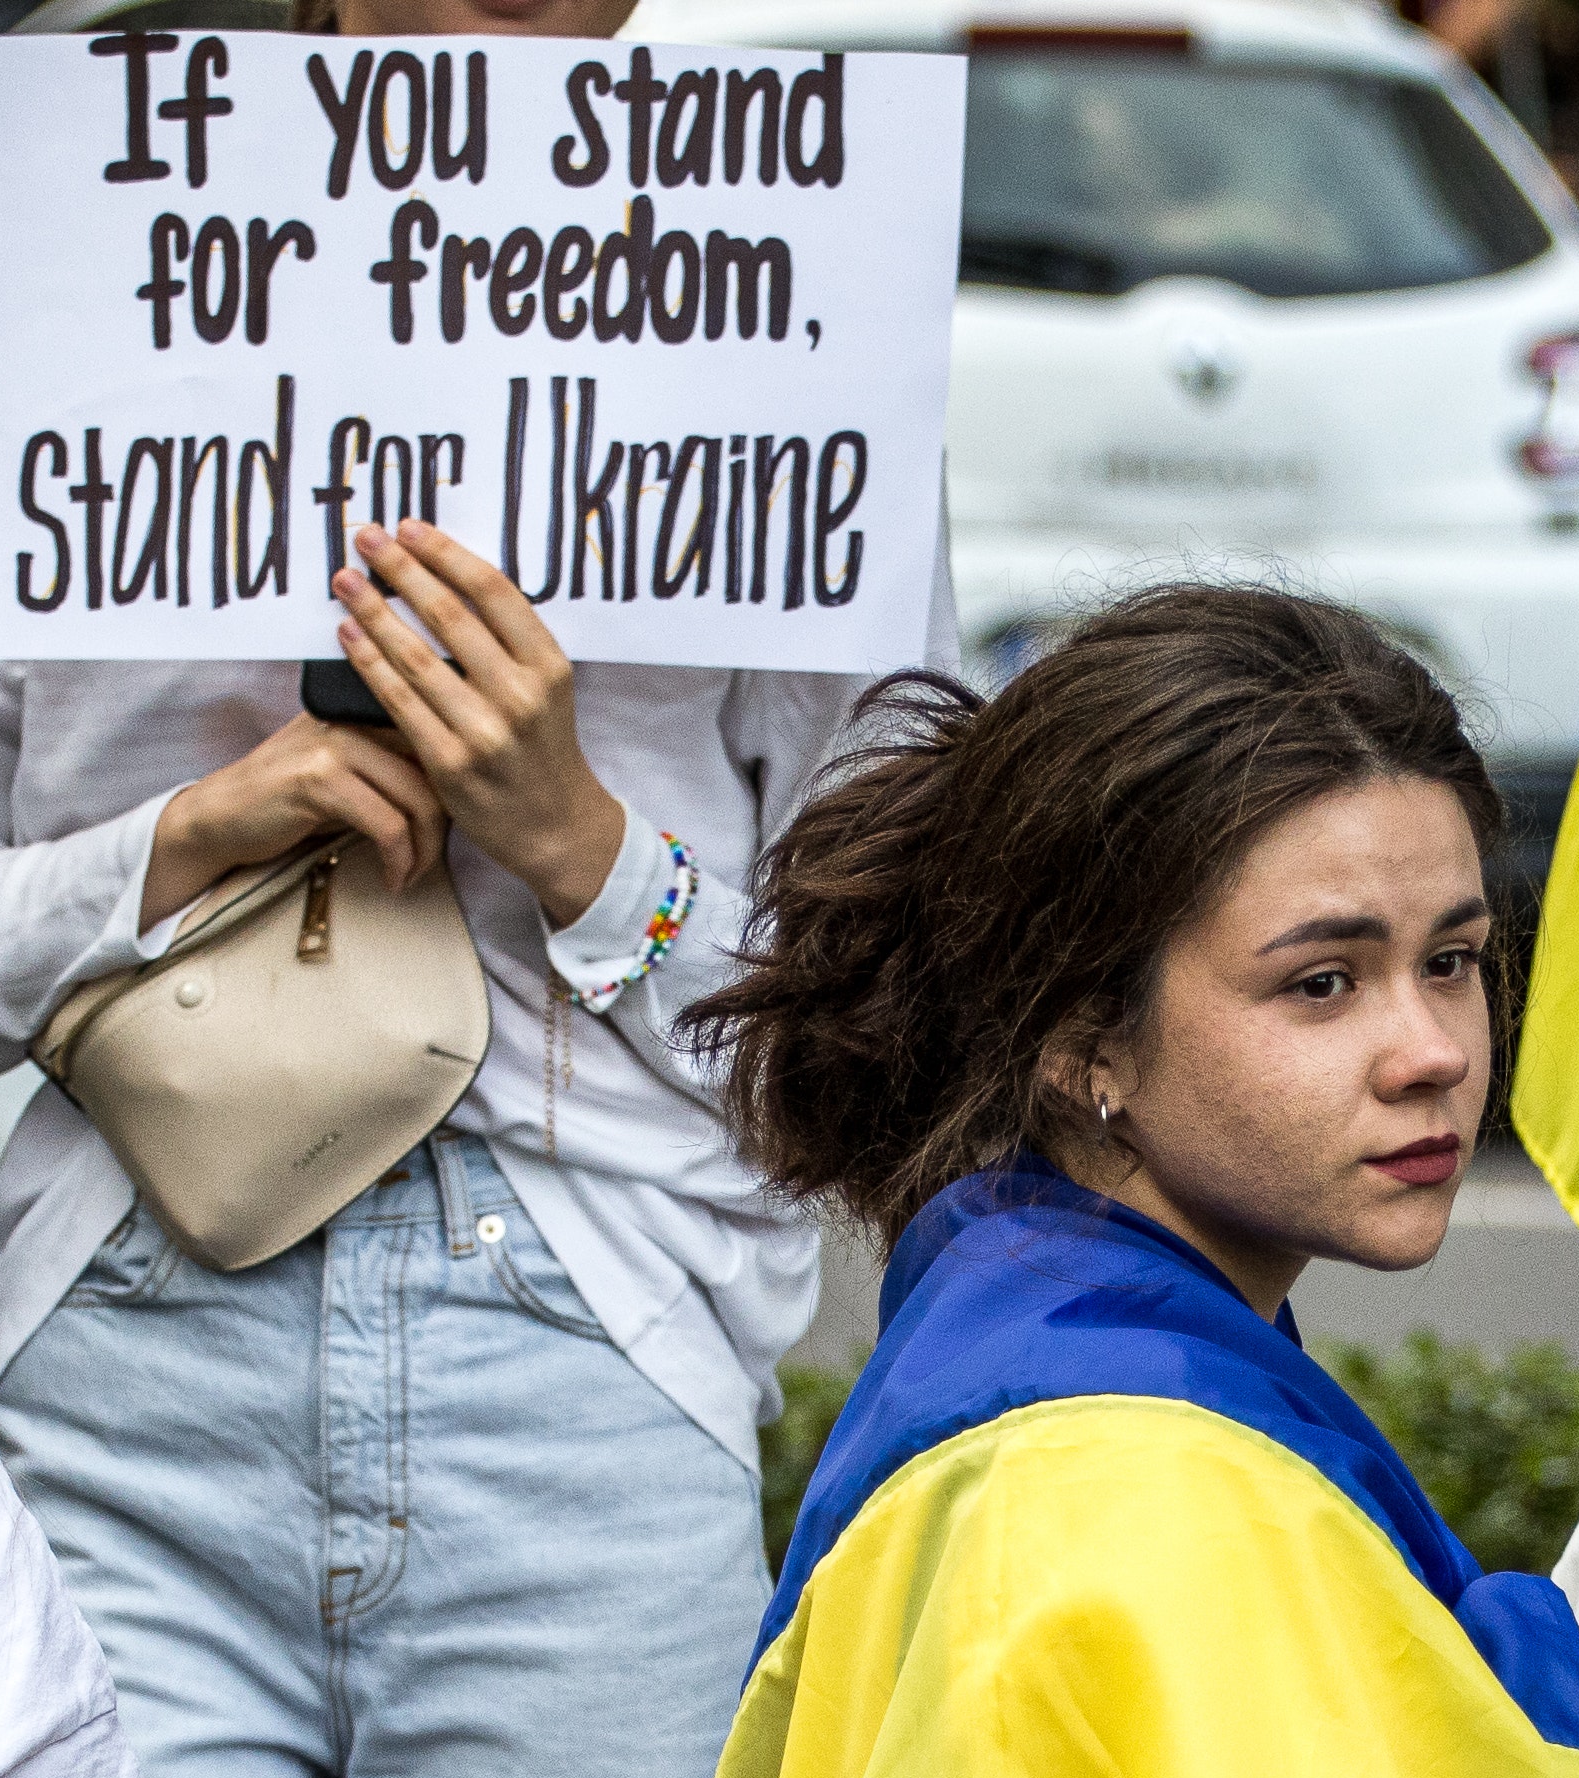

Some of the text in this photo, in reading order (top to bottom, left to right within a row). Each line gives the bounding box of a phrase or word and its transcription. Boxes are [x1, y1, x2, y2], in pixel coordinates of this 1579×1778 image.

[89, 31, 844, 199] If you stand
[136, 195, 821, 349] for freedom,
[312, 415, 463, 600] for
[500, 376, 867, 611] Ukraine
